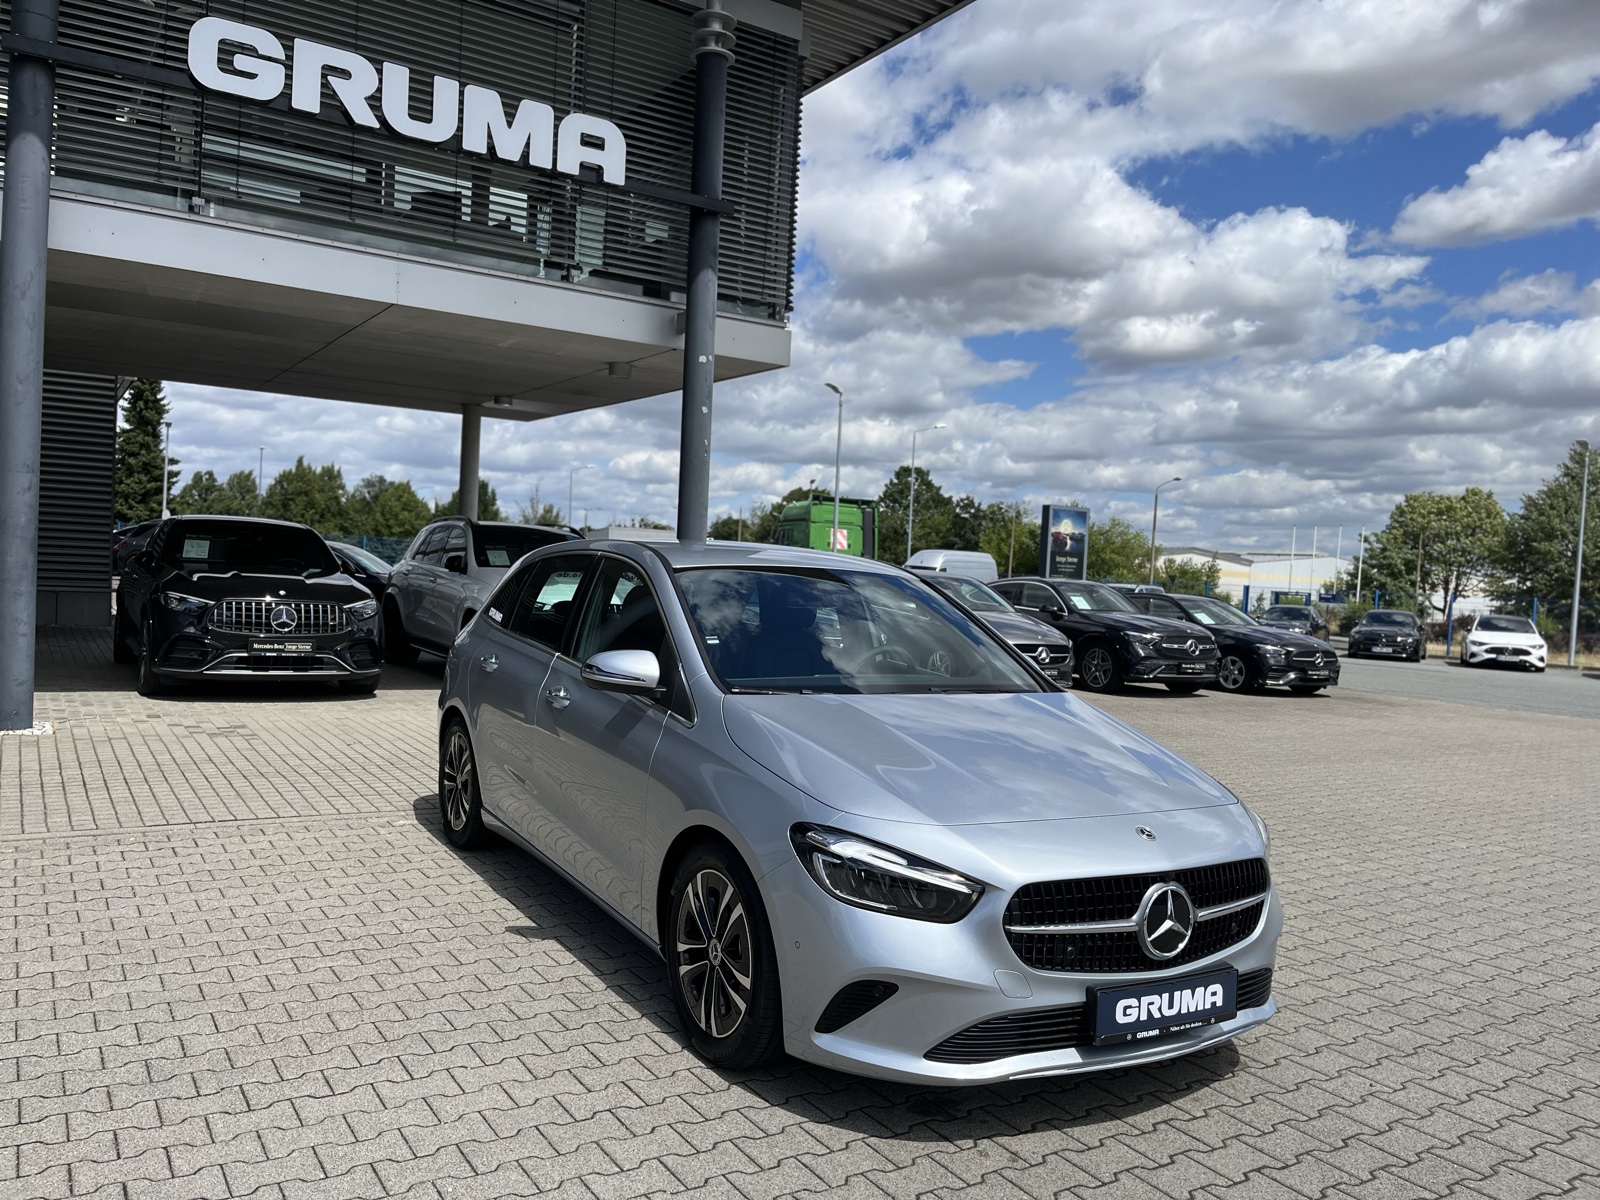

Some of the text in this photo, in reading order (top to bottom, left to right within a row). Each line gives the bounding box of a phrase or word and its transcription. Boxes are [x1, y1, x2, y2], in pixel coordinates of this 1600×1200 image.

[187, 16, 627, 186] GRUMA
[1115, 983, 1224, 1024] GRUMA
[1136, 1029, 1160, 1039] GRUMA
